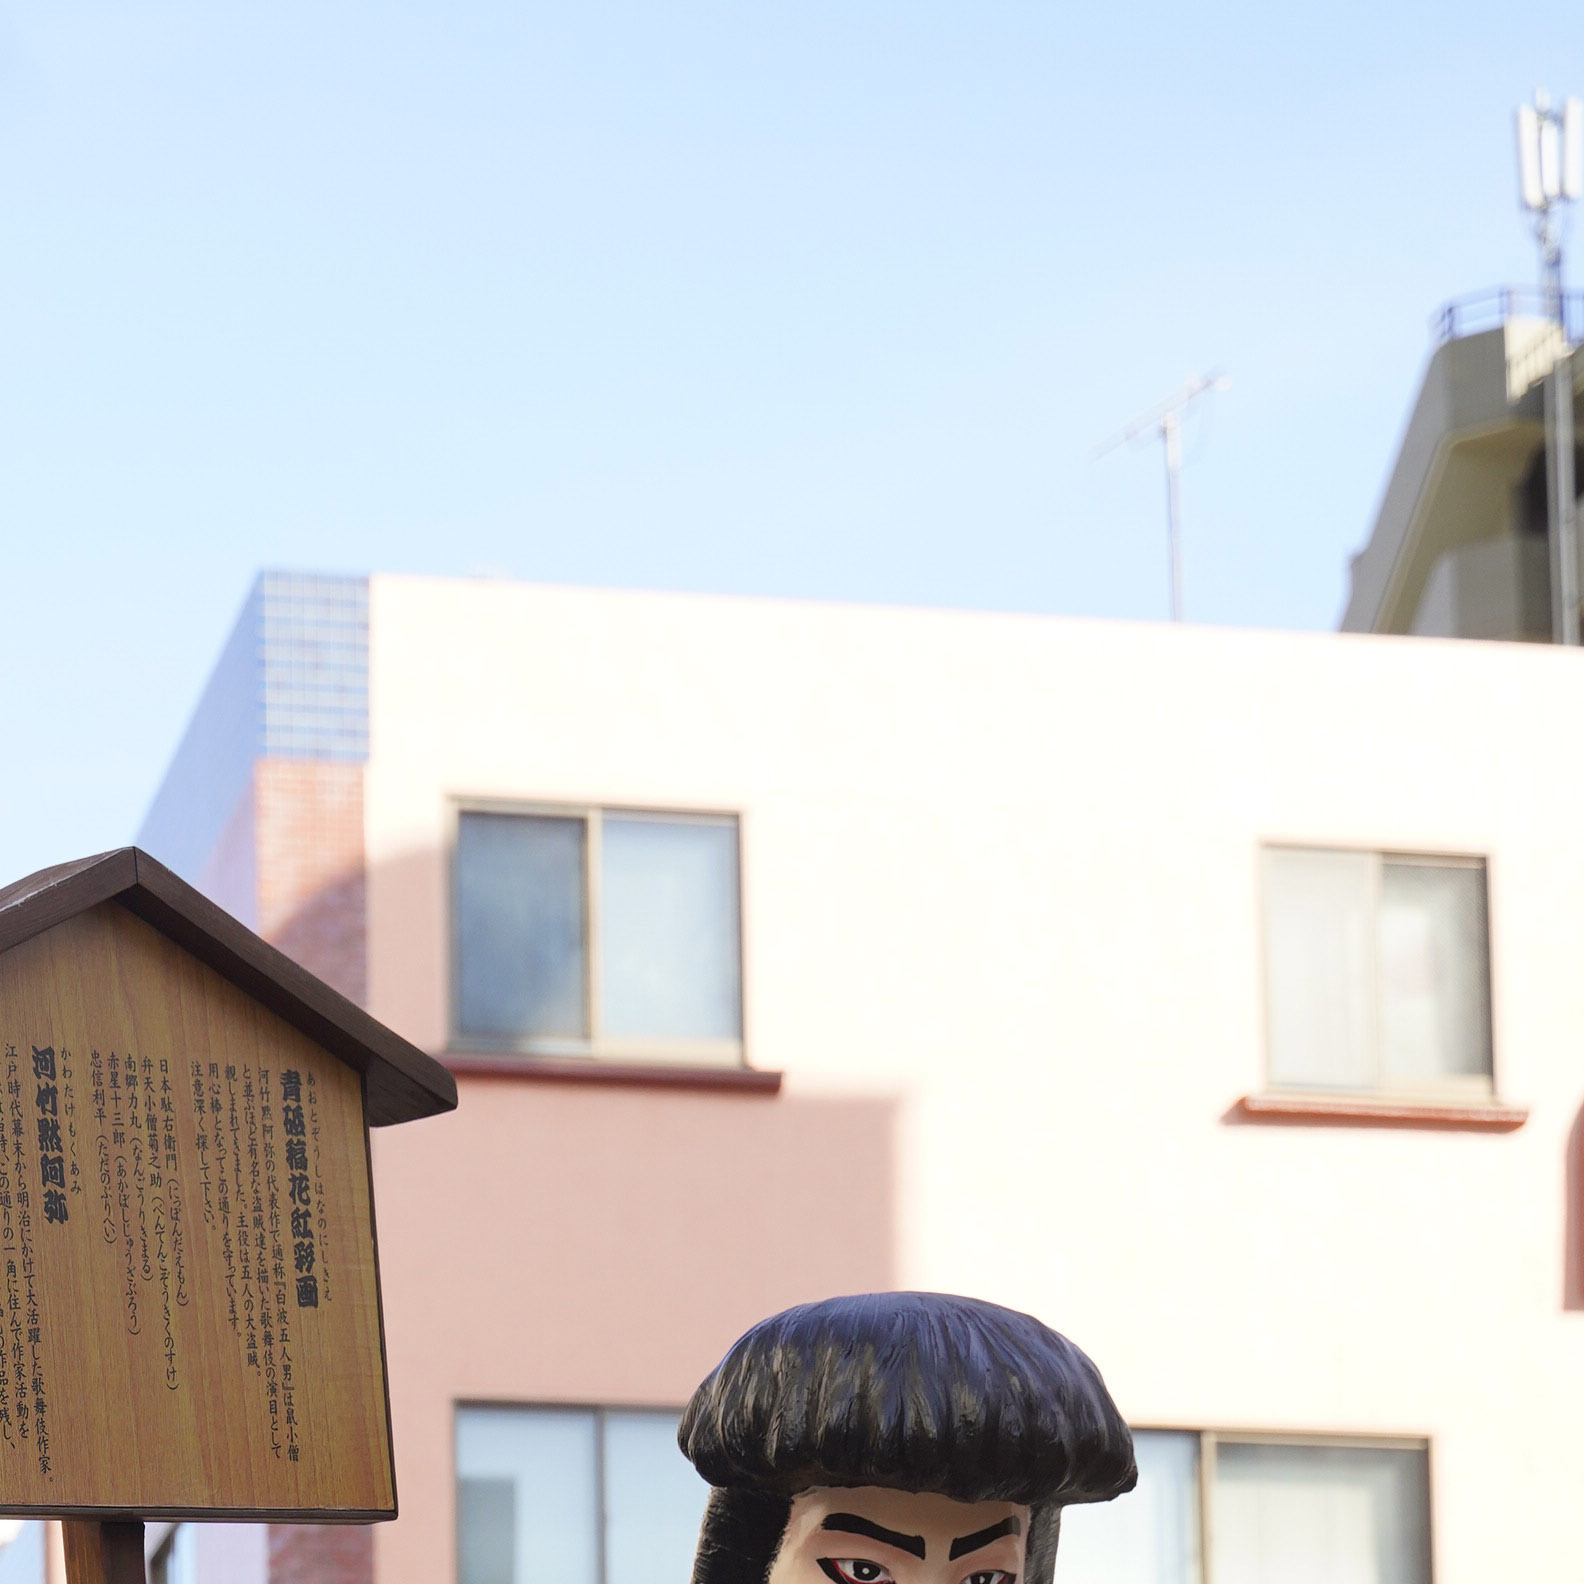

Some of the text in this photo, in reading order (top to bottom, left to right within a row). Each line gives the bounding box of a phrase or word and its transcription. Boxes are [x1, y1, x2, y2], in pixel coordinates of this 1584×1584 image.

[32, 1044, 68, 1224] 河竹黙阿弥
[61, 1047, 81, 1194] かわたけもくあみ
[191, 1061, 219, 1230] 注意深く探して下さい。
